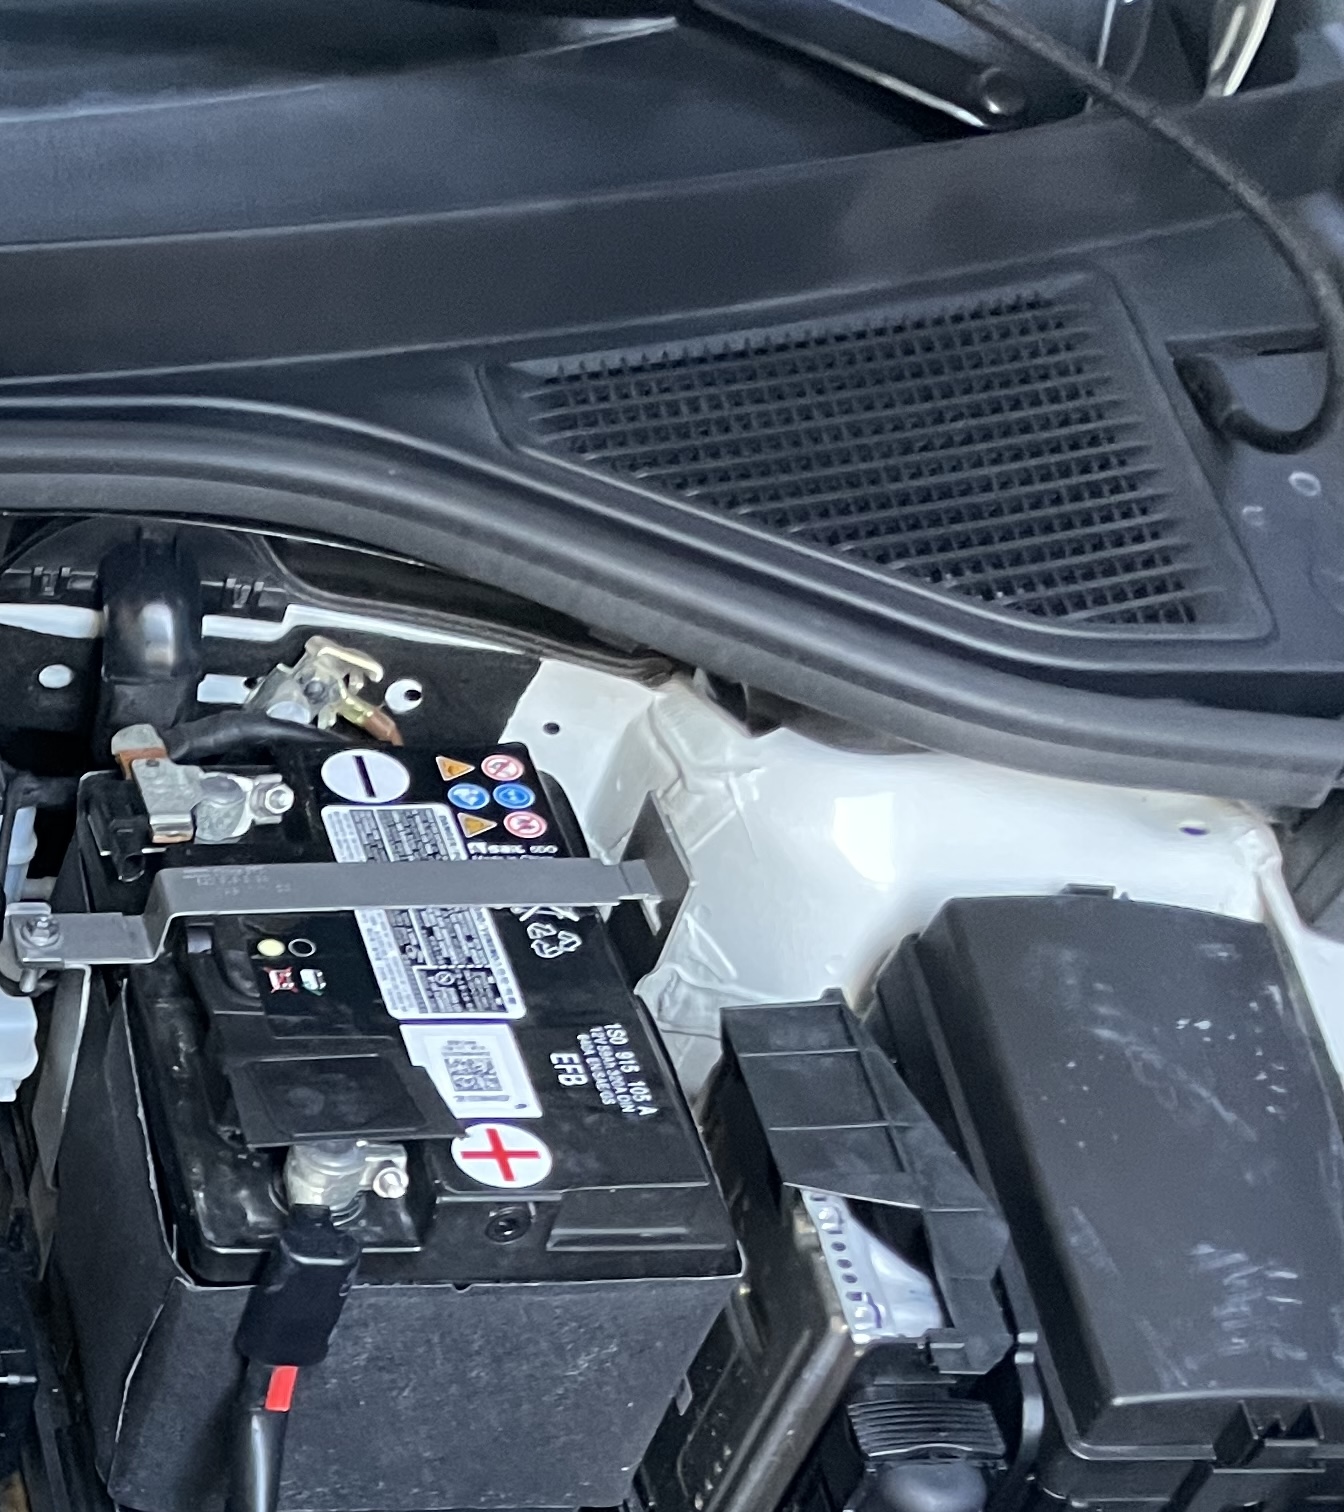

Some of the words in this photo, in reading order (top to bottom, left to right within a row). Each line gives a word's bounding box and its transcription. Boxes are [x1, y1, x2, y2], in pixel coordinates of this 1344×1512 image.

[549, 1052, 589, 1086] EFB
[615, 1051, 640, 1073] 915
[628, 1080, 652, 1102] 105
[616, 1094, 636, 1113] DIN
[638, 1106, 659, 1116] A
